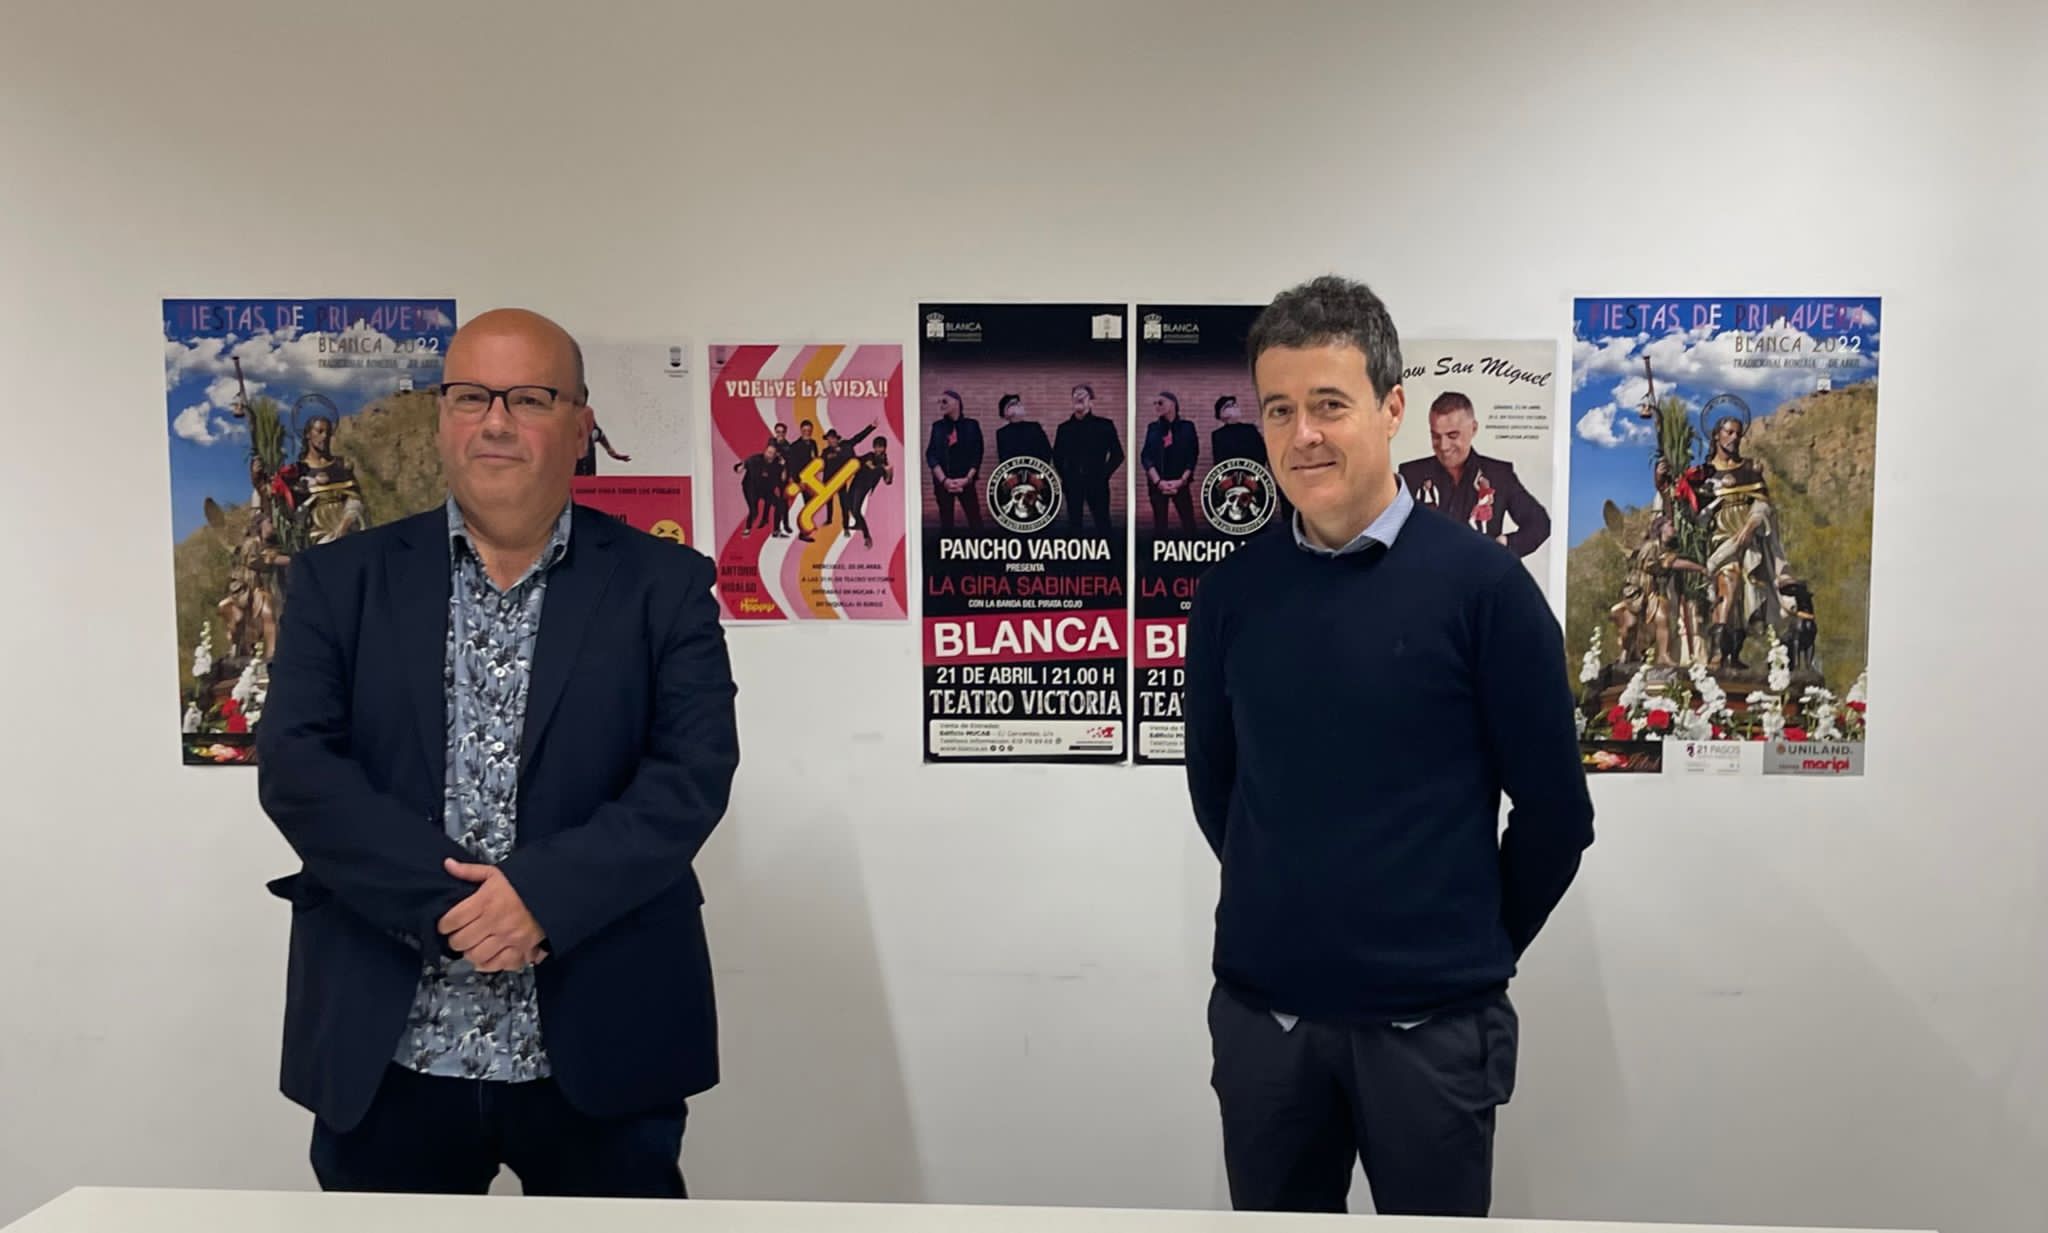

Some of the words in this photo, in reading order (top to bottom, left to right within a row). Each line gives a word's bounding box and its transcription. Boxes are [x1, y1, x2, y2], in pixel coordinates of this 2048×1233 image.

[180, 306, 265, 331] FIESTAS
[277, 306, 304, 330] DE
[1589, 304, 1680, 330] FIESTAS
[1692, 304, 1722, 330] DE
[1735, 304, 1865, 330] PRIMAVERA
[946, 322, 982, 331] BLANCA
[1163, 323, 1199, 332] BLANCA
[318, 337, 382, 353] BLANCA
[393, 336, 440, 354] 2022
[1735, 335, 1802, 353] BLANCA
[1812, 335, 1861, 353] 2022
[1401, 365, 1426, 380] ow
[1433, 356, 1475, 376] San
[1479, 356, 1553, 387] Miguel
[725, 380, 796, 398] VUELVE
[801, 380, 827, 398] LA
[832, 380, 889, 398] VIDA!!
[940, 539, 1022, 561] PANCHO
[1028, 539, 1111, 561] VARONA
[1153, 540, 1236, 563] PANCHO
[721, 566, 758, 577] ANTONIO
[1006, 563, 1045, 573] PRESENTA
[929, 576, 954, 597] LA
[961, 576, 1011, 597] GIRA
[1017, 575, 1123, 597] SABINERA
[1142, 577, 1167, 598] LA
[968, 600, 984, 609] CON
[985, 600, 995, 608] LA
[996, 600, 1020, 608] BANDA
[1022, 600, 1037, 608] DEL
[1038, 600, 1062, 608] PIRATA
[1063, 600, 1082, 608] COJO
[1180, 601, 1192, 610] CO
[934, 616, 1120, 657] BLANCA
[937, 667, 955, 685] 21
[962, 667, 985, 685] DE
[989, 667, 1038, 685] ABRIL
[1052, 667, 1098, 685] 21.00
[1102, 667, 1115, 685] H
[1147, 669, 1167, 686] 21
[1173, 669, 1185, 686] D
[929, 690, 1014, 715] TEATRO
[1021, 690, 1123, 715] VICTORIA
[1139, 692, 1185, 717] TEA
[1698, 745, 1708, 755] 21
[1711, 745, 1741, 755] PASOS
[1803, 758, 1850, 772] maripi
